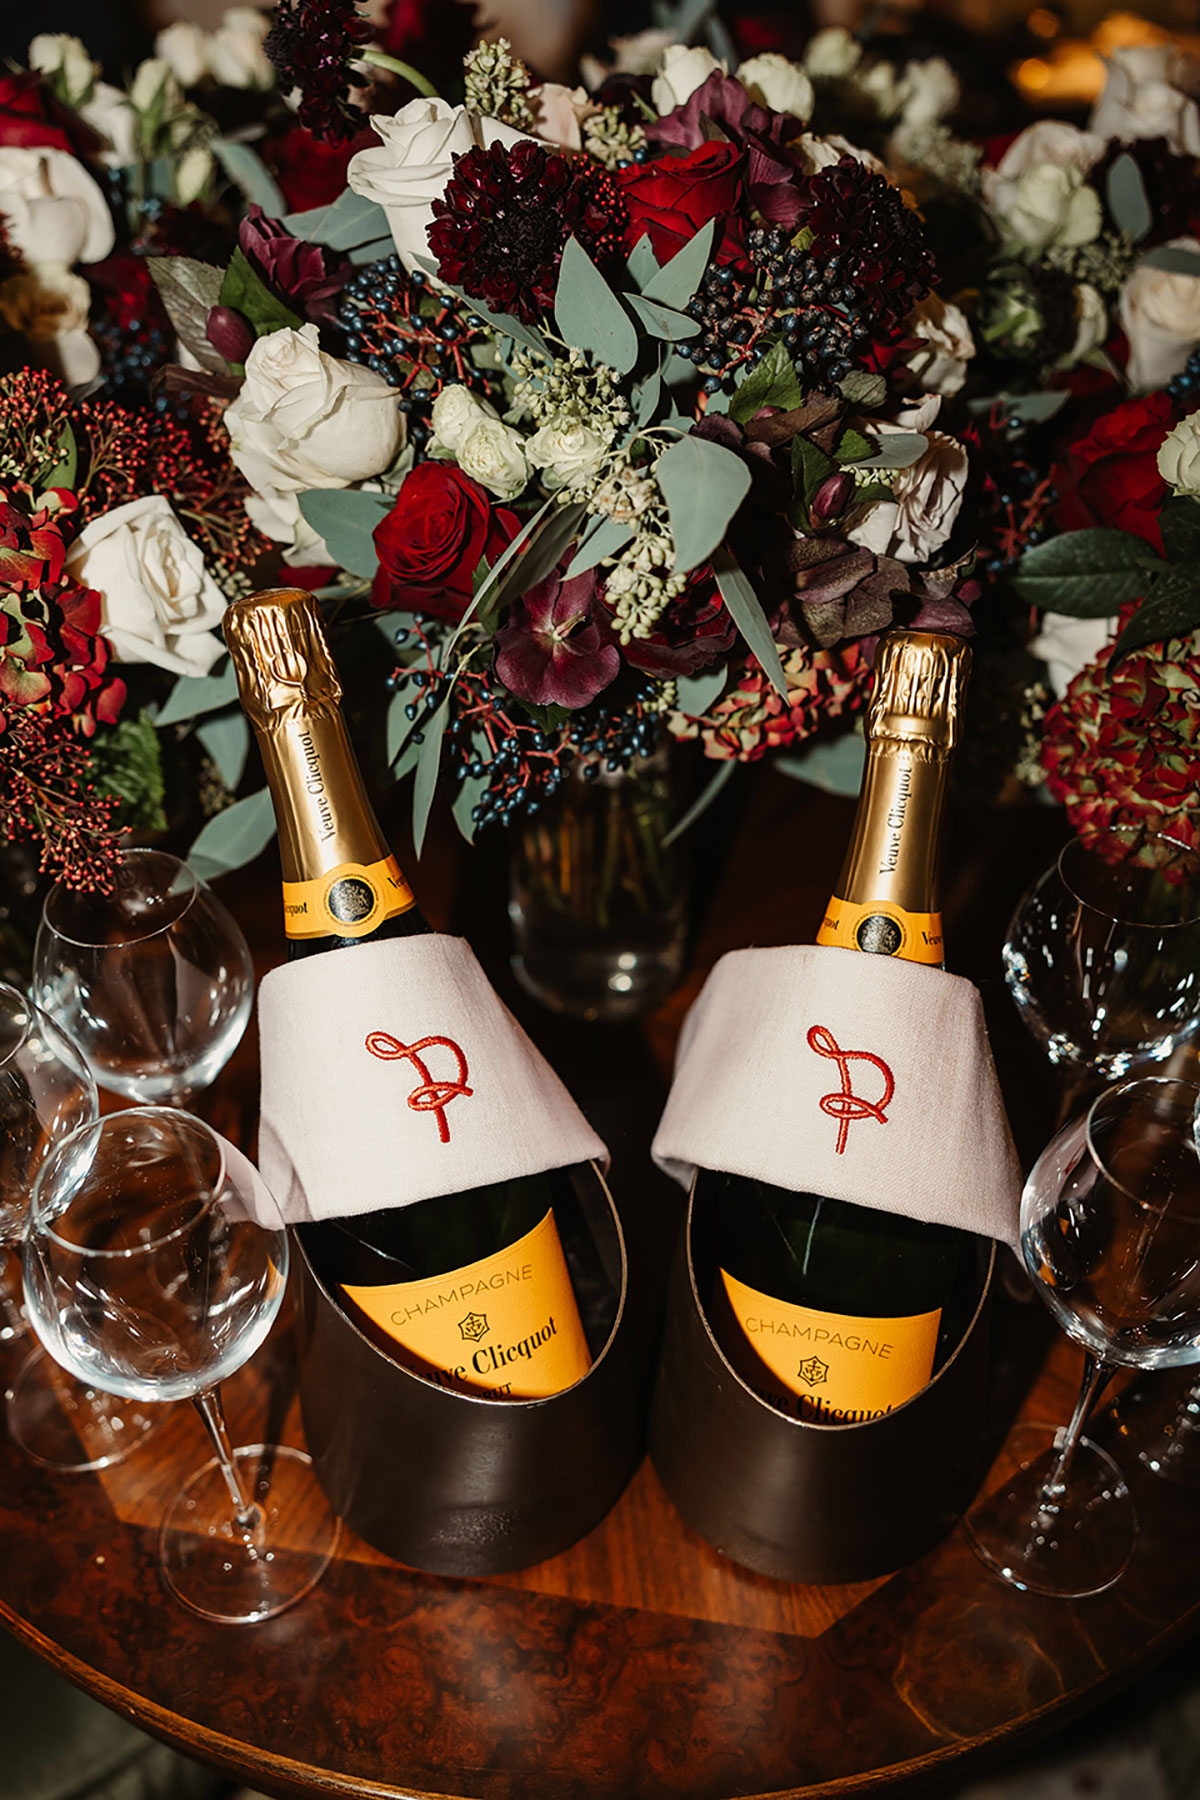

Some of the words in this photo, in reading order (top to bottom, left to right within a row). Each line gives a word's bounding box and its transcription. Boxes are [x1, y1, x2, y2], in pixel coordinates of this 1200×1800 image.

[297, 730, 325, 796] Clicquot
[316, 797, 336, 842] Veuve
[886, 766, 912, 830] Clicquot
[879, 832, 902, 876] Veuve
[390, 1264, 533, 1326] CHAMPAGNE
[471, 1316, 558, 1375] Clicquot
[744, 1317, 894, 1360] CHAMPAGNE
[480, 1381, 512, 1401] RUT
